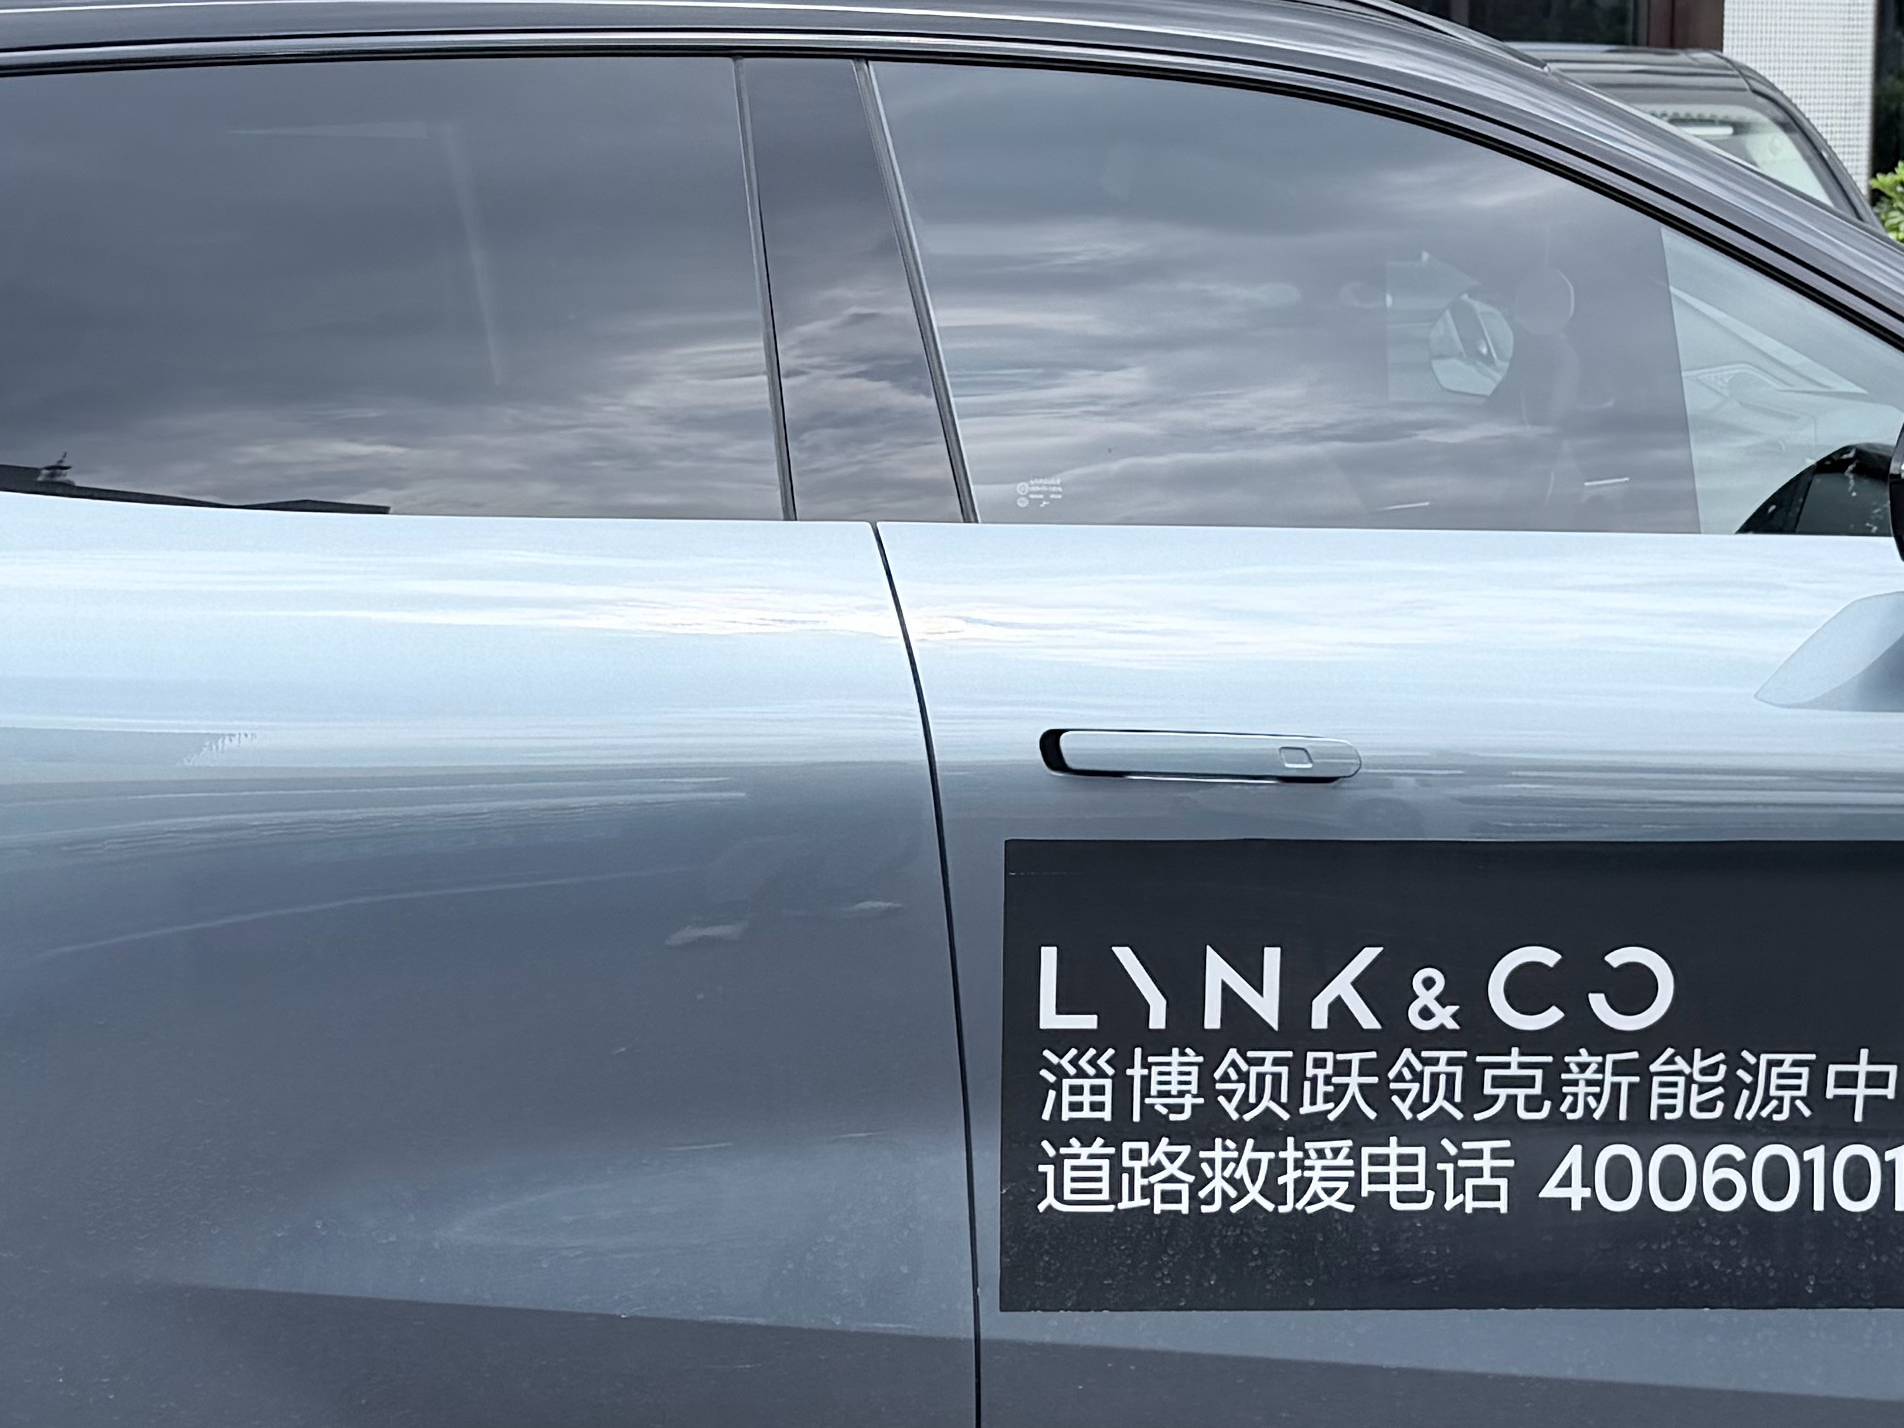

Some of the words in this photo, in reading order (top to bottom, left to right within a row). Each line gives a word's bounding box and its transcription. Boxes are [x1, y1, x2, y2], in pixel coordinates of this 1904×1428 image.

[1037, 1137, 1512, 1216] 道路救援电话
